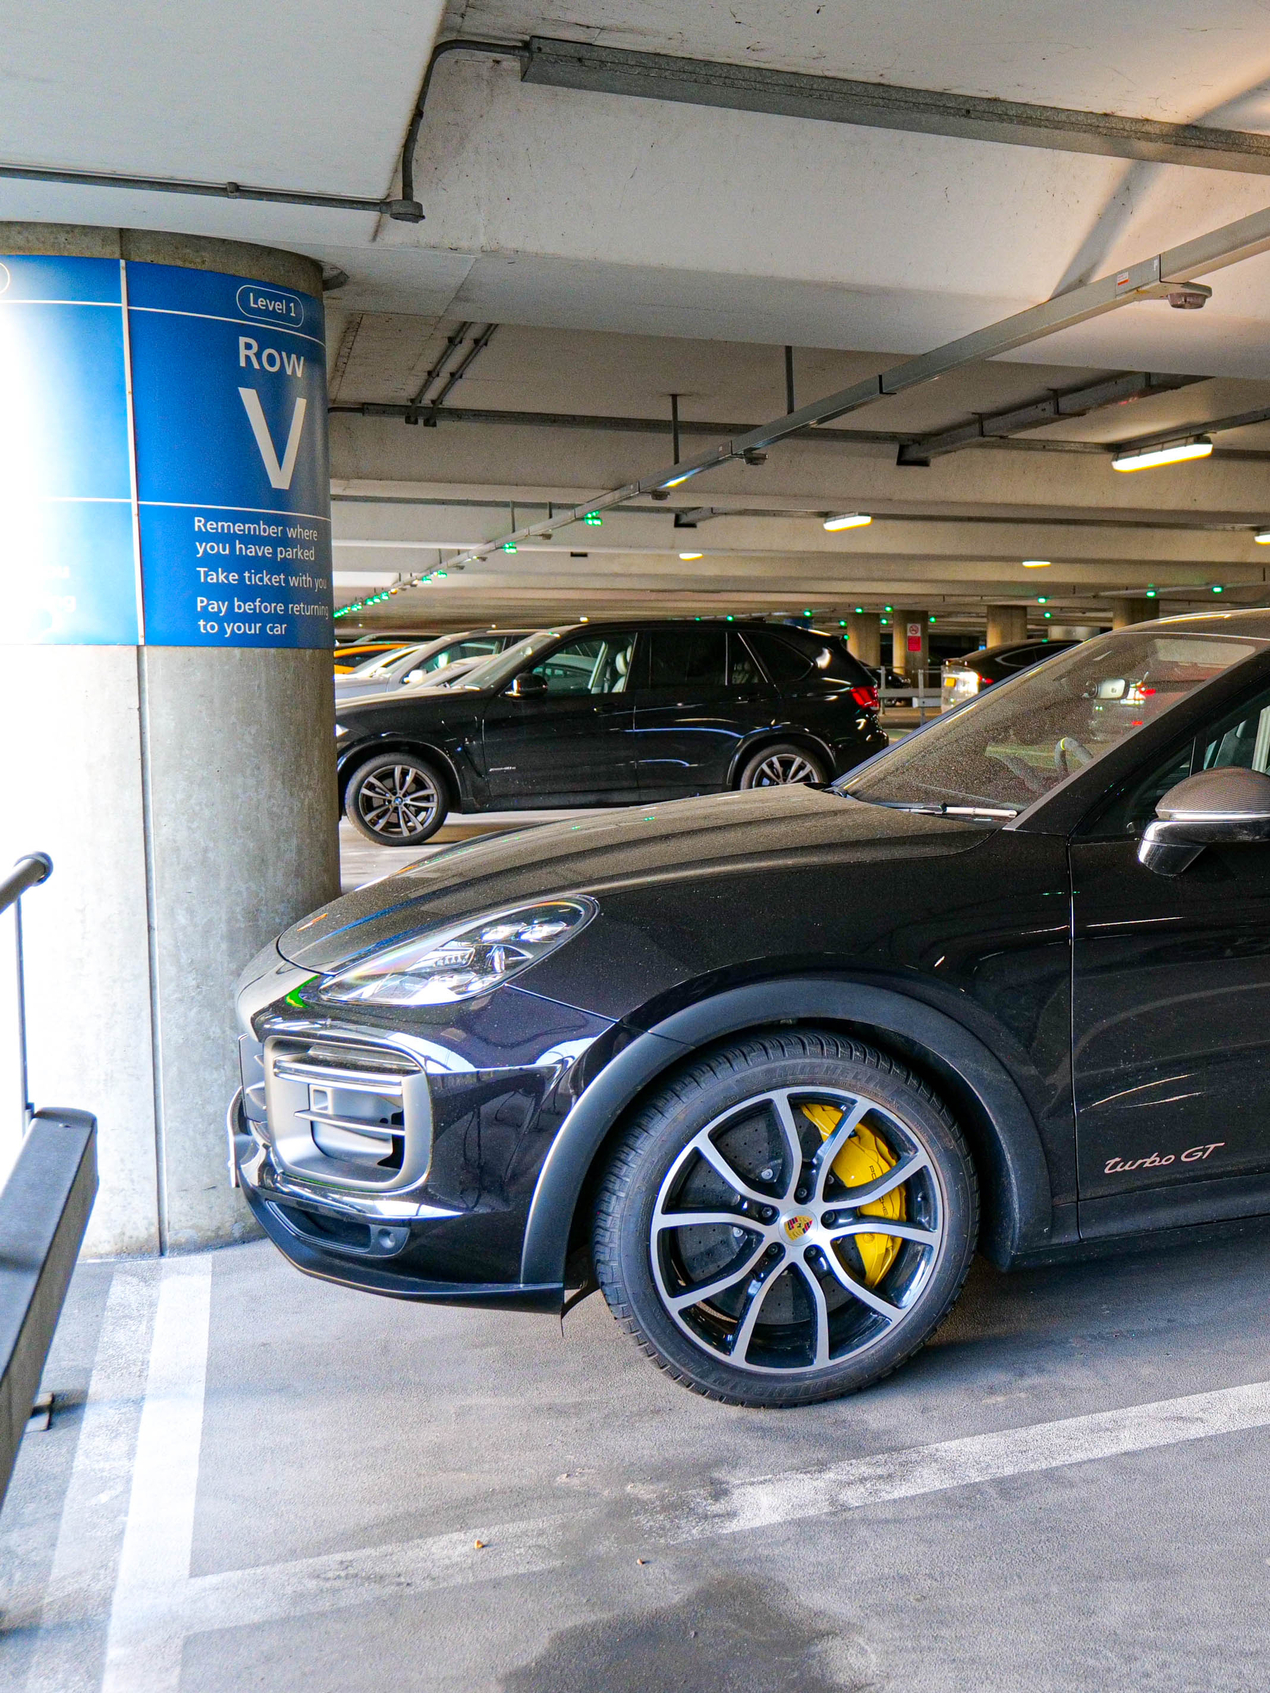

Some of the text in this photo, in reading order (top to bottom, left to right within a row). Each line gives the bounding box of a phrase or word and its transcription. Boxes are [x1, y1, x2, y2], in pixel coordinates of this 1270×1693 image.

[249, 292, 296, 317] Level 1
[238, 335, 305, 378] Row
[238, 386, 307, 490] V
[194, 516, 318, 541] Remember where
[195, 540, 315, 561] you have parked
[196, 567, 328, 592] Take ticket with you
[196, 596, 329, 619] Pay before returning
[198, 619, 288, 637] to your car
[1103, 1142, 1226, 1174] turbo GT
